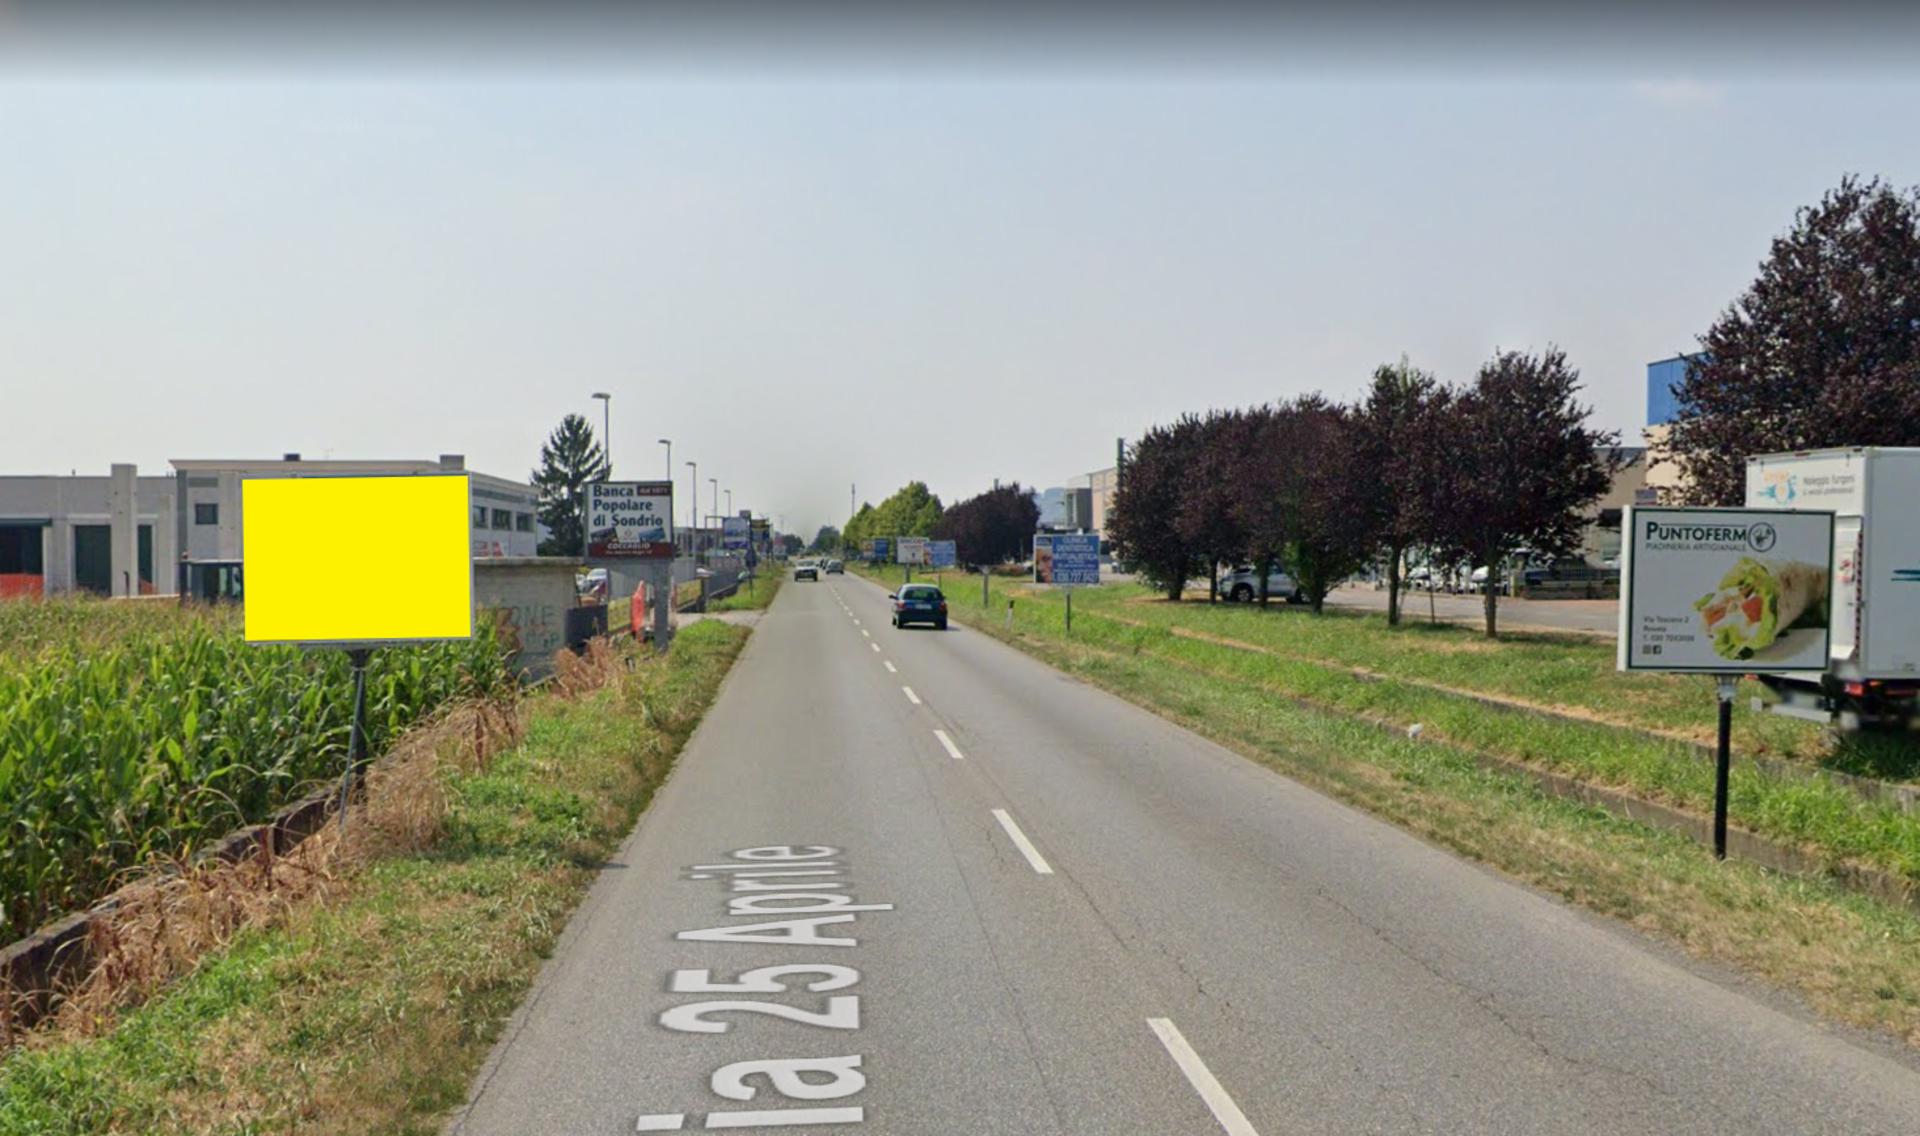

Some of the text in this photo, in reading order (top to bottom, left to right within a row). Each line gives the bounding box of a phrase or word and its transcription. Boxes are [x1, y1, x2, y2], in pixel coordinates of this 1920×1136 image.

[593, 485, 634, 497] Banca
[593, 499, 653, 513] Popolare
[593, 513, 663, 527] di Sondrio
[1692, 543, 1746, 552] ARTIGIANALE
